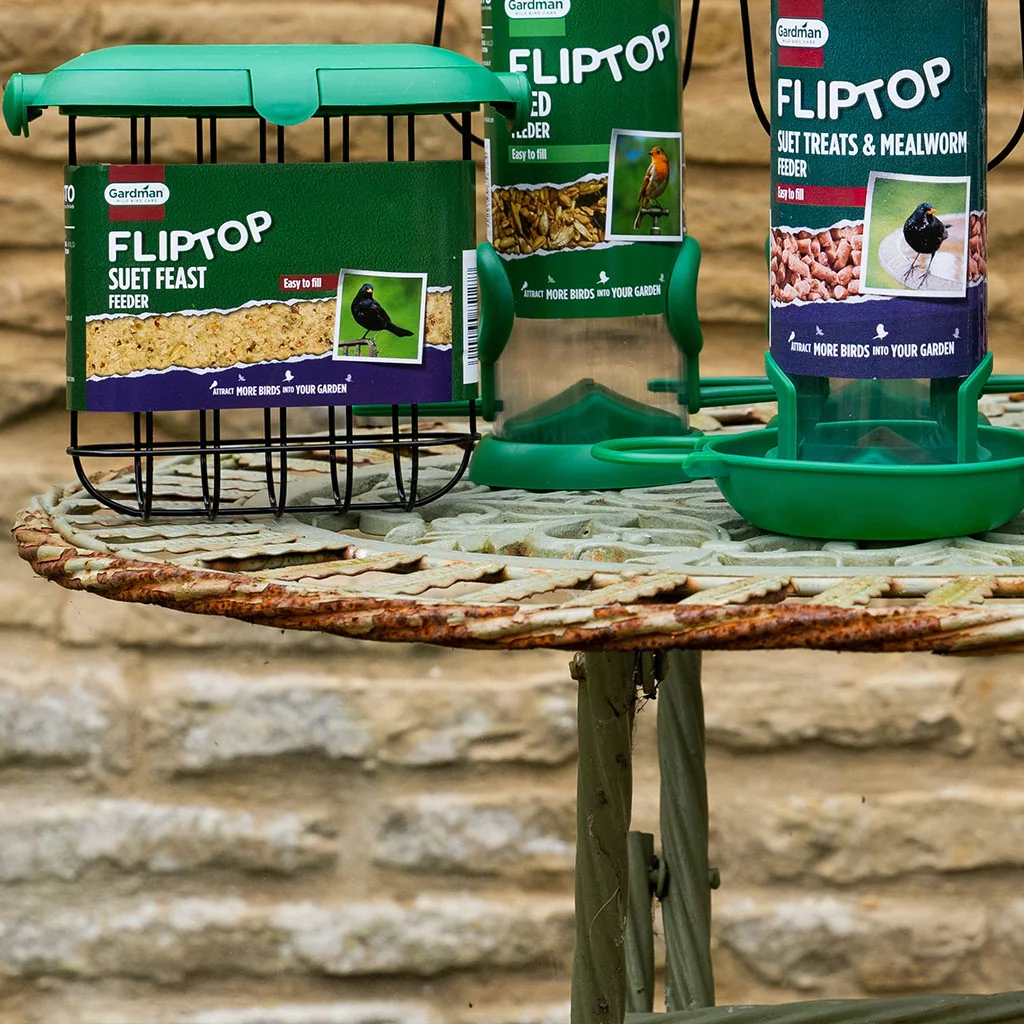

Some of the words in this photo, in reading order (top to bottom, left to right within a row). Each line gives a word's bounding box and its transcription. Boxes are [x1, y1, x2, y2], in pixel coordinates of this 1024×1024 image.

[778, 24, 821, 39] Gardman
[509, 24, 671, 85] FLIPTOP
[777, 56, 951, 120] FLIPTOP
[531, 91, 551, 117] ED
[777, 130, 801, 154] SUET
[803, 132, 858, 156] TREATS
[862, 133, 876, 156] &
[880, 131, 967, 156] MEALWORM
[511, 148, 526, 162] Easy
[527, 149, 535, 160] to
[536, 148, 547, 160] fill
[777, 159, 807, 178] FEEDER
[109, 186, 164, 199] Gardman
[777, 186, 788, 201] Easy
[788, 187, 795, 200] to
[795, 187, 804, 201] fill
[108, 210, 272, 262] FLIPTOP
[108, 268, 151, 290] SUET
[156, 266, 207, 289] FEAST
[283, 278, 301, 290] Easy
[302, 279, 310, 288] to
[312, 278, 322, 288] fill
[523, 289, 543, 298] ATTRACT
[546, 289, 569, 300] MORE
[570, 288, 595, 300] BIRDS
[597, 289, 610, 297] INTO
[611, 287, 632, 298] YOUR
[634, 284, 661, 297] GARDEN
[108, 295, 149, 309] FEEDER
[791, 342, 811, 353] ATTRACT
[813, 342, 838, 357] MORE
[841, 344, 870, 357] BIRDS
[872, 346, 889, 356] INTO
[891, 343, 917, 357] YOUR
[920, 341, 954, 356] GARDEN
[212, 386, 234, 396] ATTRACT
[236, 385, 257, 397] MORE
[258, 384, 281, 396] BIRDS
[282, 386, 294, 394] INTO
[295, 384, 316, 395] YOUR
[317, 383, 347, 394] GARDEN
